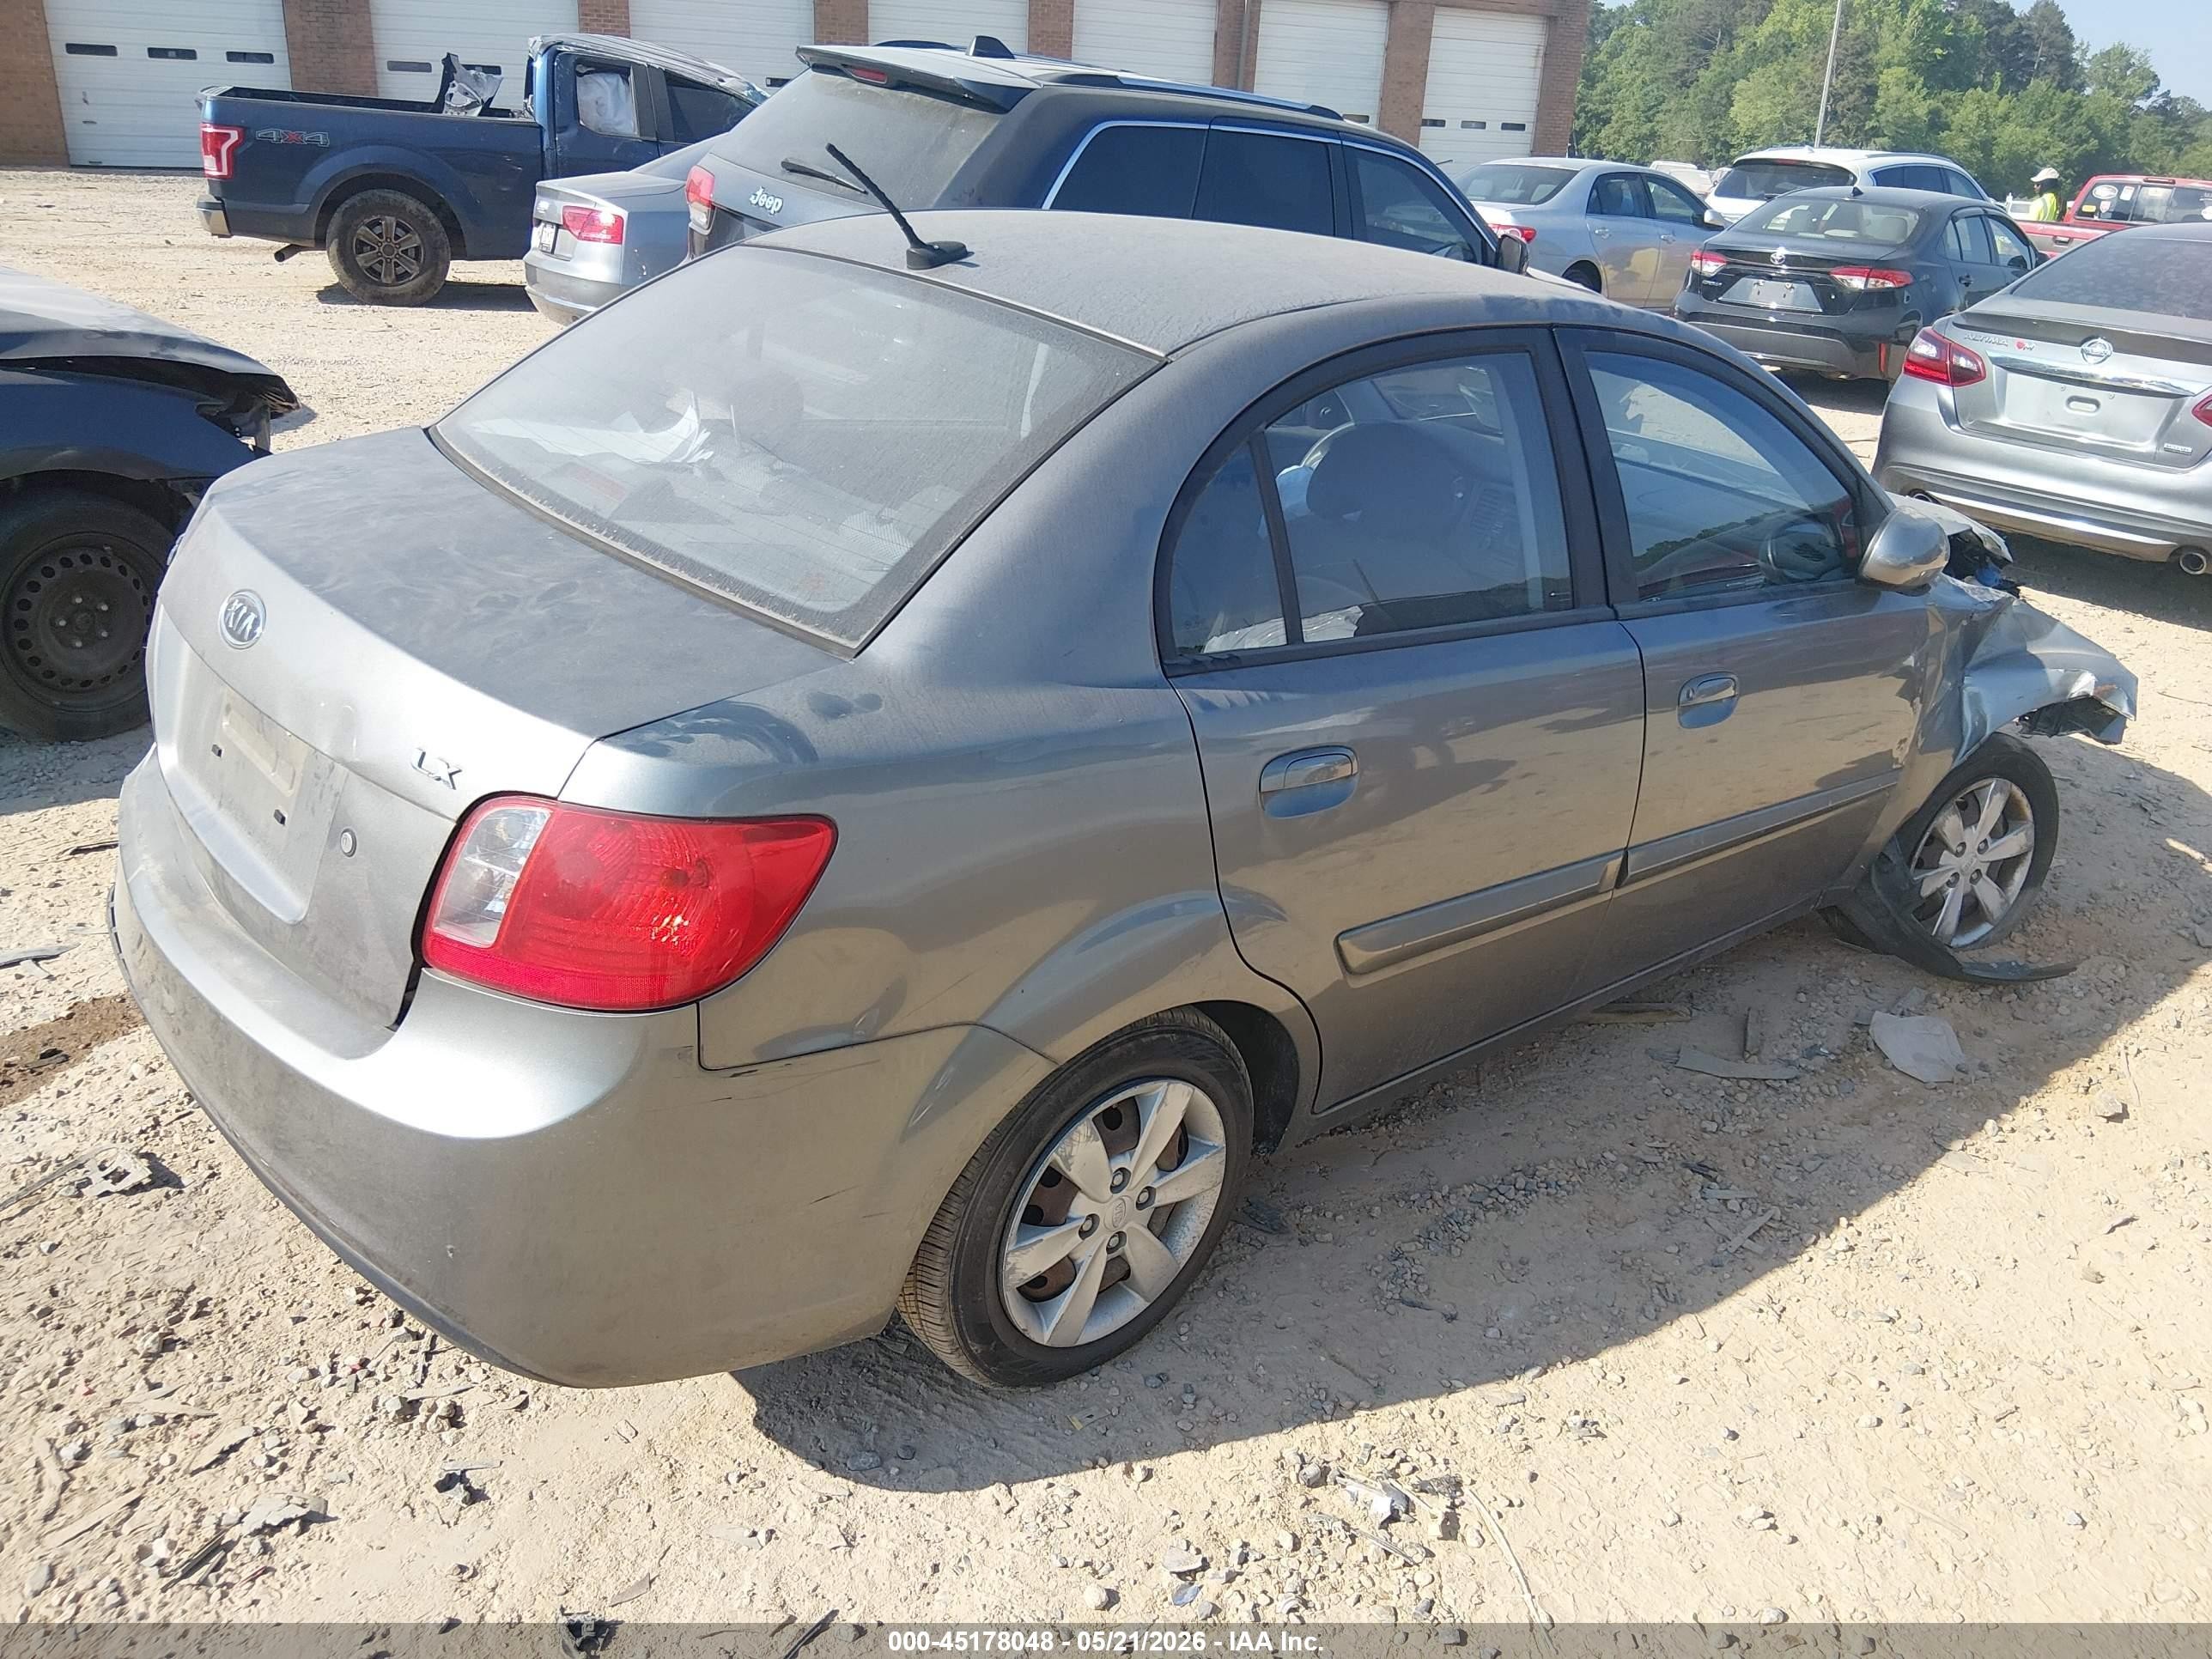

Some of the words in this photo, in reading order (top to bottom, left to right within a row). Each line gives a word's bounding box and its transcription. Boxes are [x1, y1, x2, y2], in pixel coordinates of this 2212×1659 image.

[749, 185, 783, 215] Jeep
[1964, 334, 2008, 347] ALTIMA
[410, 747, 462, 790] LX
